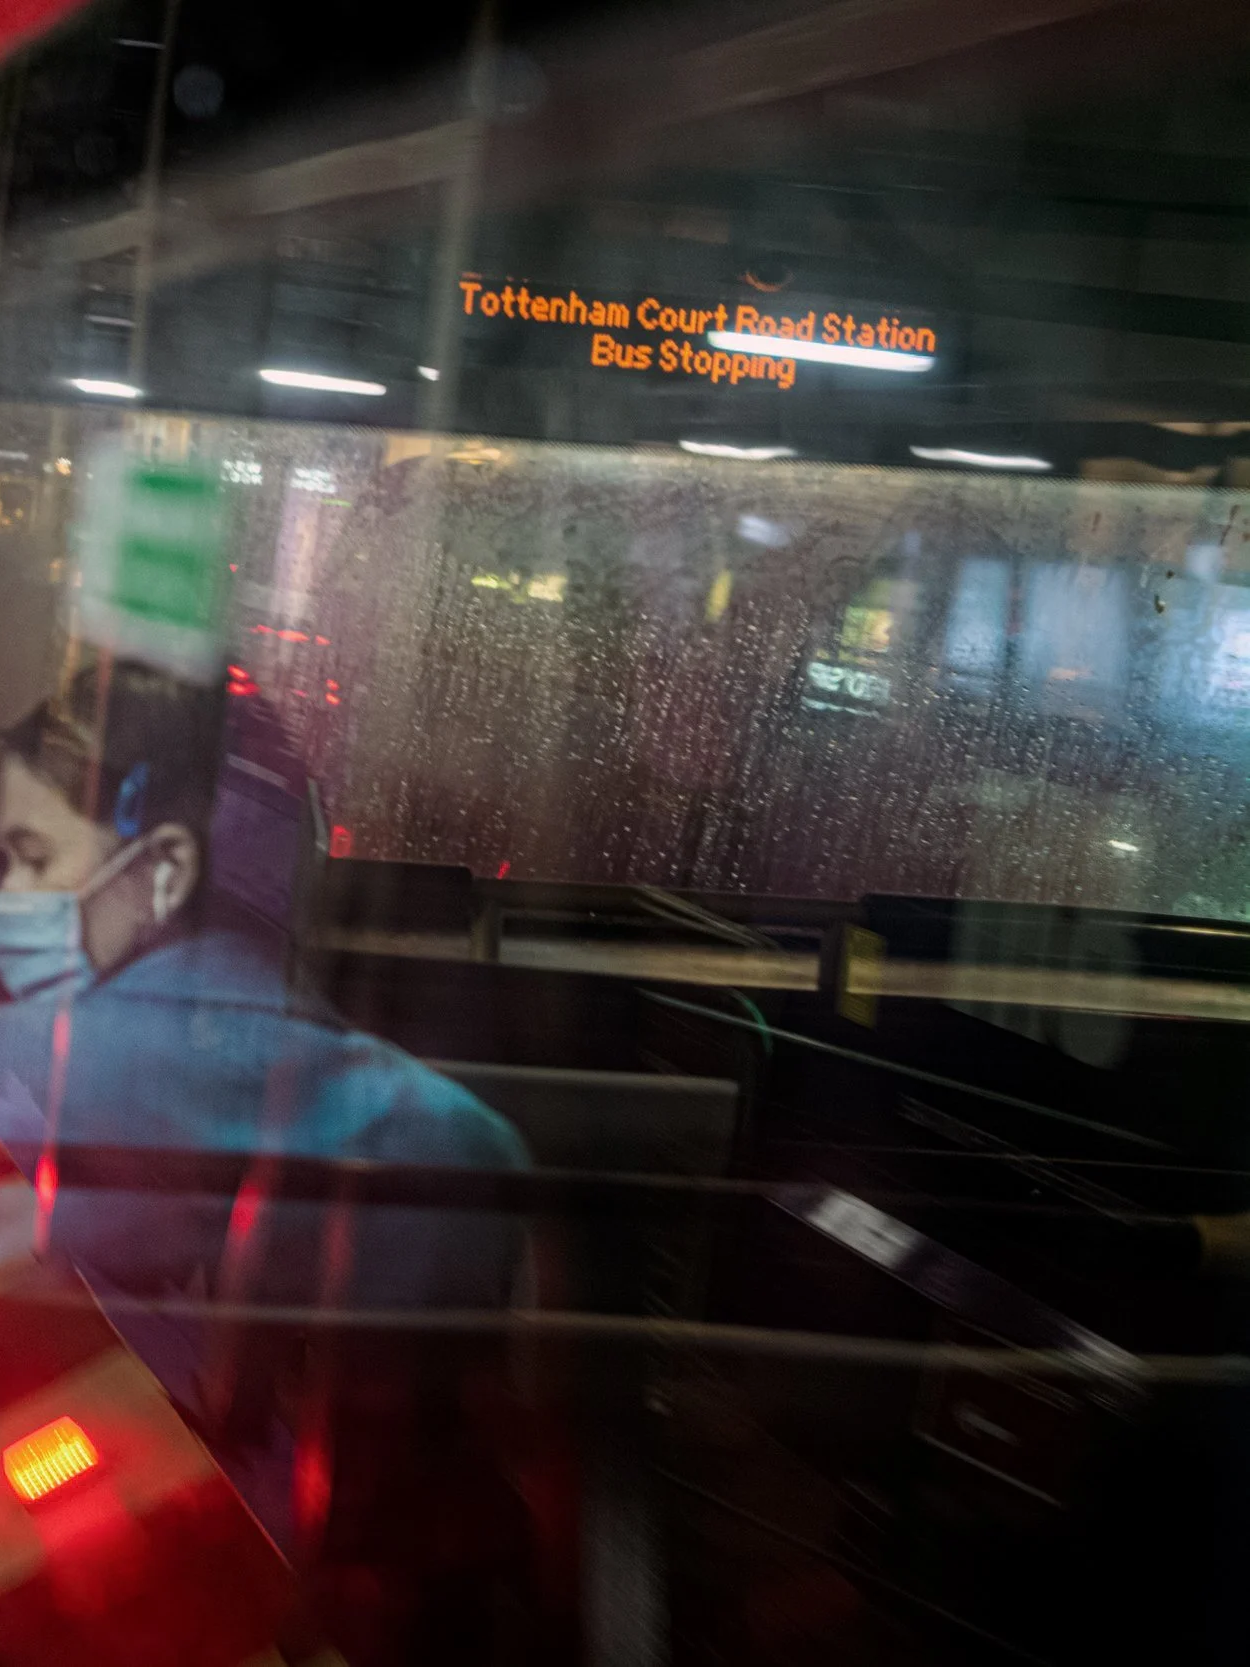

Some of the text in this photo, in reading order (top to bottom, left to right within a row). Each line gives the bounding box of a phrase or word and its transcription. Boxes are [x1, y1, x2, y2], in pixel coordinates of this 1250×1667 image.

[459, 282, 936, 352] Tottenham Court Road Station
[591, 333, 796, 390] Bus Stopping
